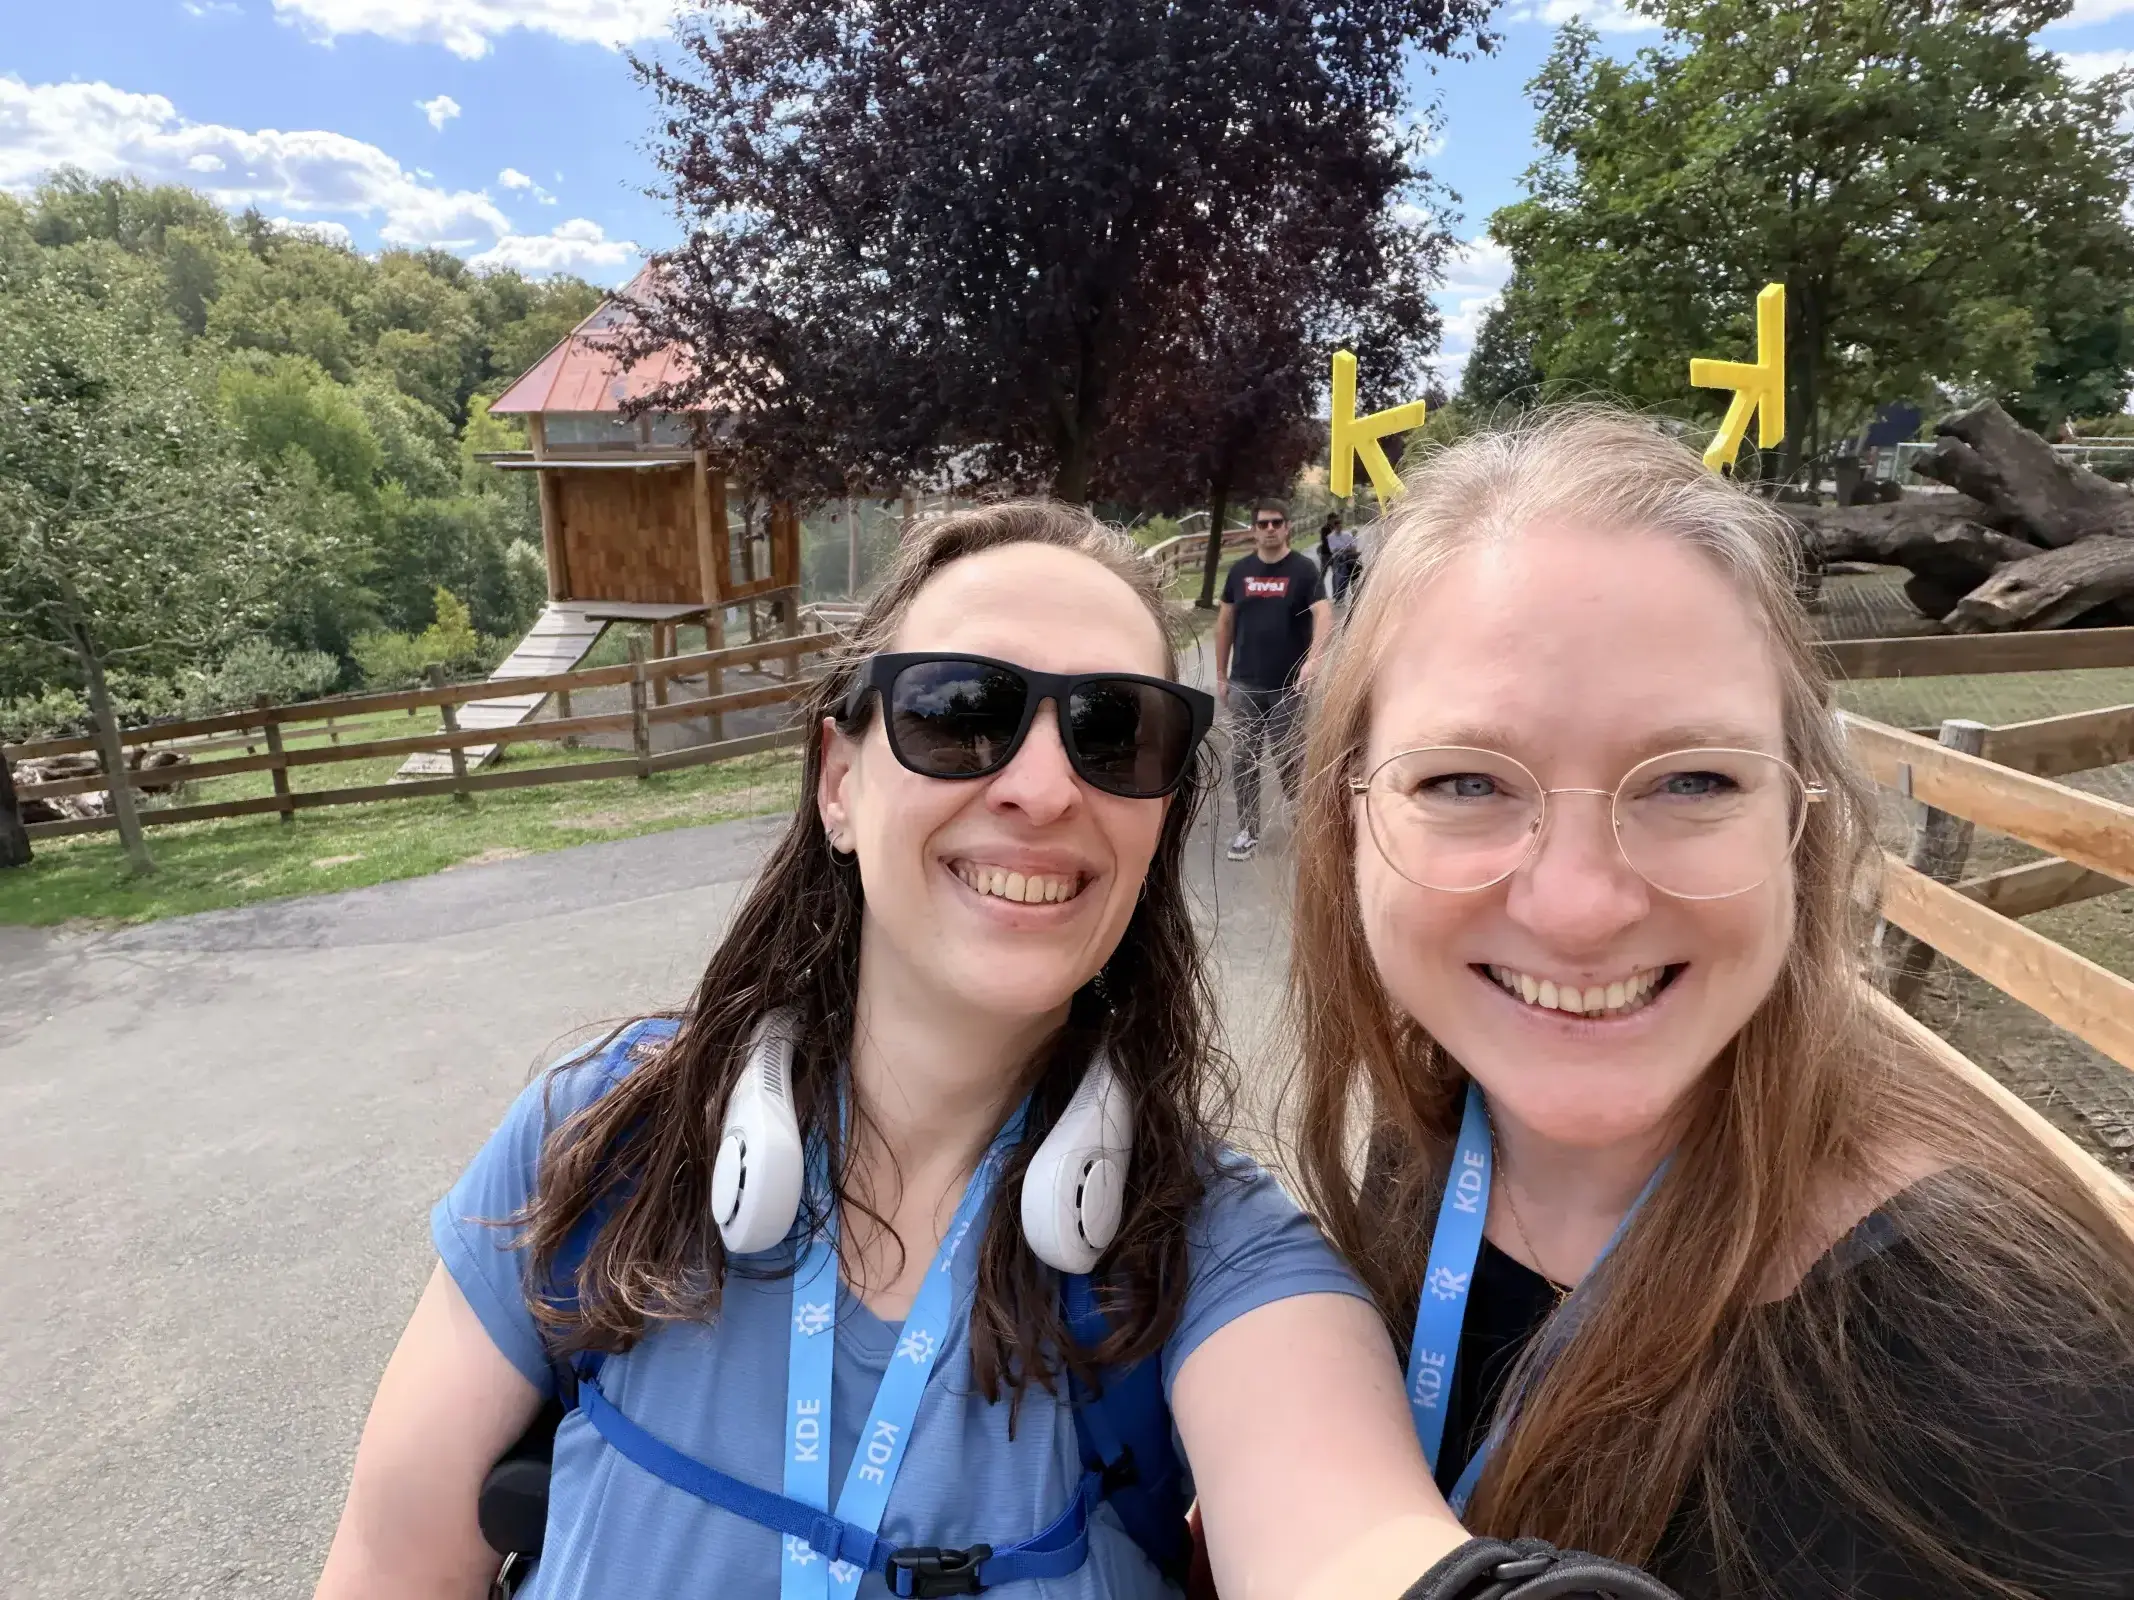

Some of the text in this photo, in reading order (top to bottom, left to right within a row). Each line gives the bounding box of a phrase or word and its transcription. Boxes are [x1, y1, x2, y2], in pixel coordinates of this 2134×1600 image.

[1452, 1149, 1485, 1214] KDE
[1413, 1348, 1446, 1409] KDE
[795, 1398, 820, 1462] KDE
[858, 1419, 900, 1485] KDE
